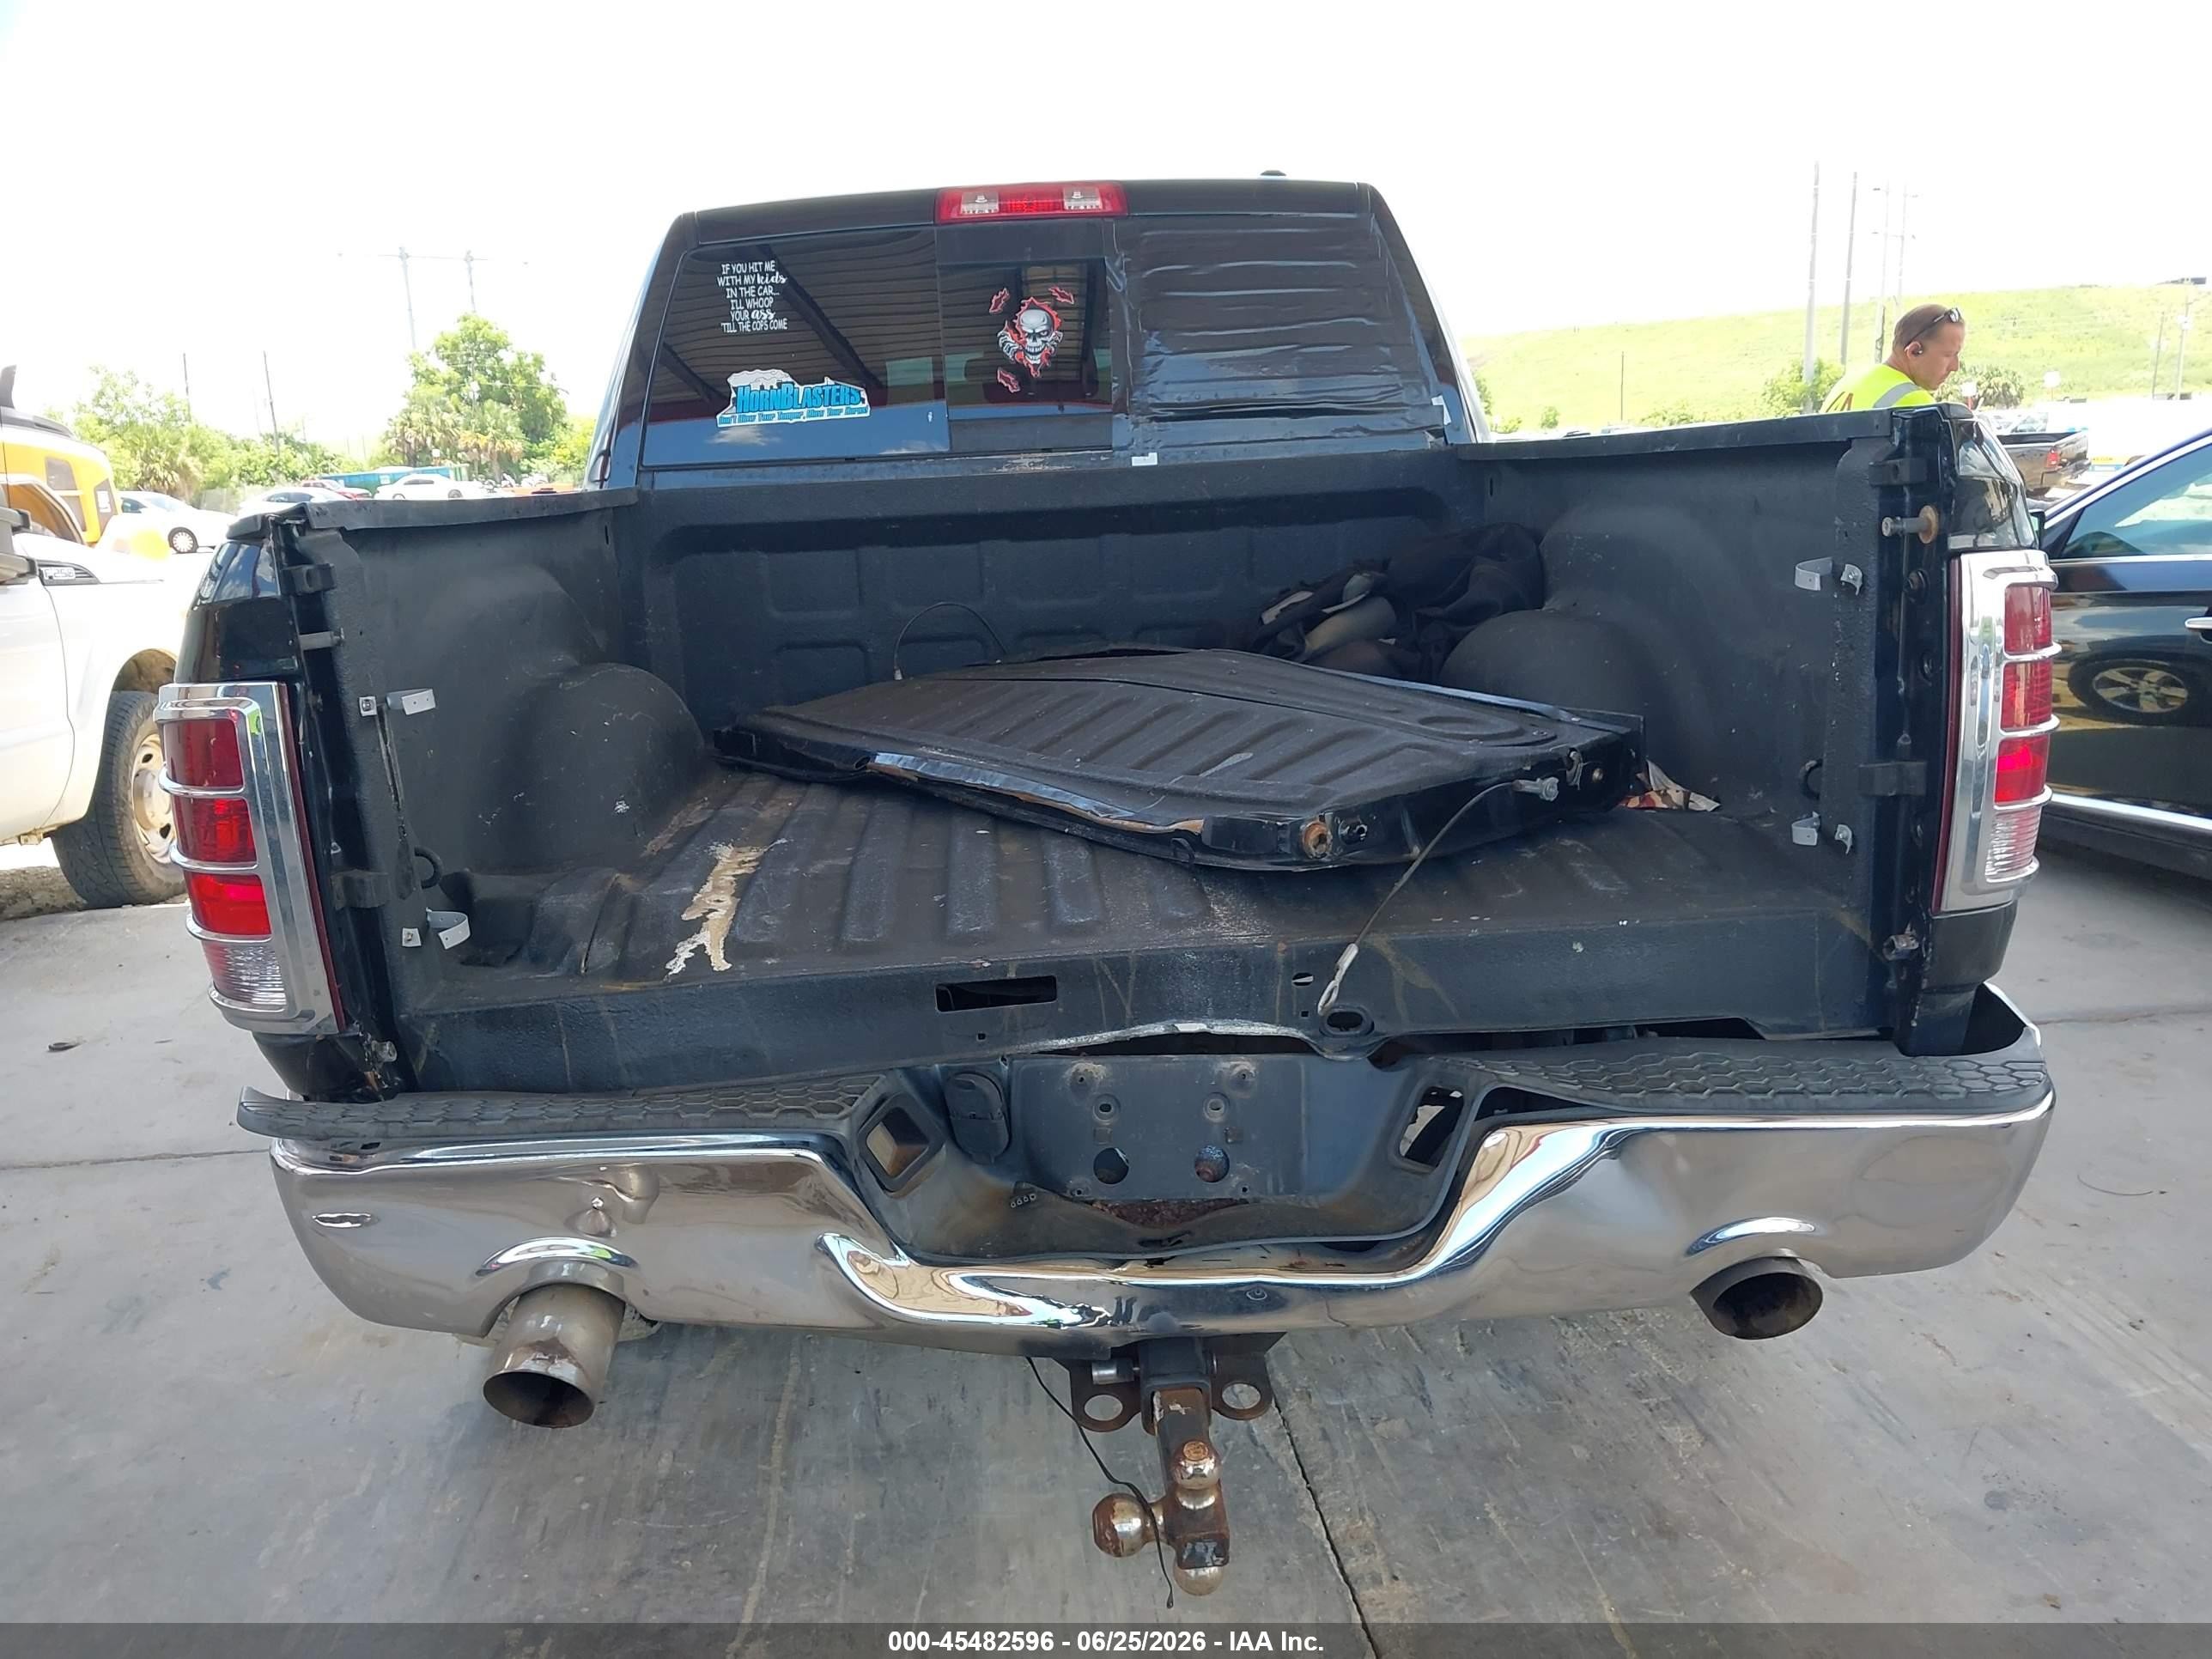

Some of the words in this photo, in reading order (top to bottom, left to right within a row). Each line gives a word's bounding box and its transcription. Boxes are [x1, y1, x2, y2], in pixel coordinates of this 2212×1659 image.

[721, 263, 731, 275] IF
[731, 263, 747, 274] YOU
[749, 262, 763, 273] HIT
[764, 260, 775, 272] ME
[716, 275, 742, 287] WITH
[744, 274, 756, 285] MY
[757, 271, 788, 284] kids
[726, 287, 738, 298] IN
[738, 286, 756, 297] THE
[745, 297, 774, 309] WHOOP
[730, 310, 750, 322] YOUR
[750, 309, 776, 320] ass
[738, 320, 751, 332] THE
[751, 320, 769, 331] COPS
[769, 318, 788, 331] COME
